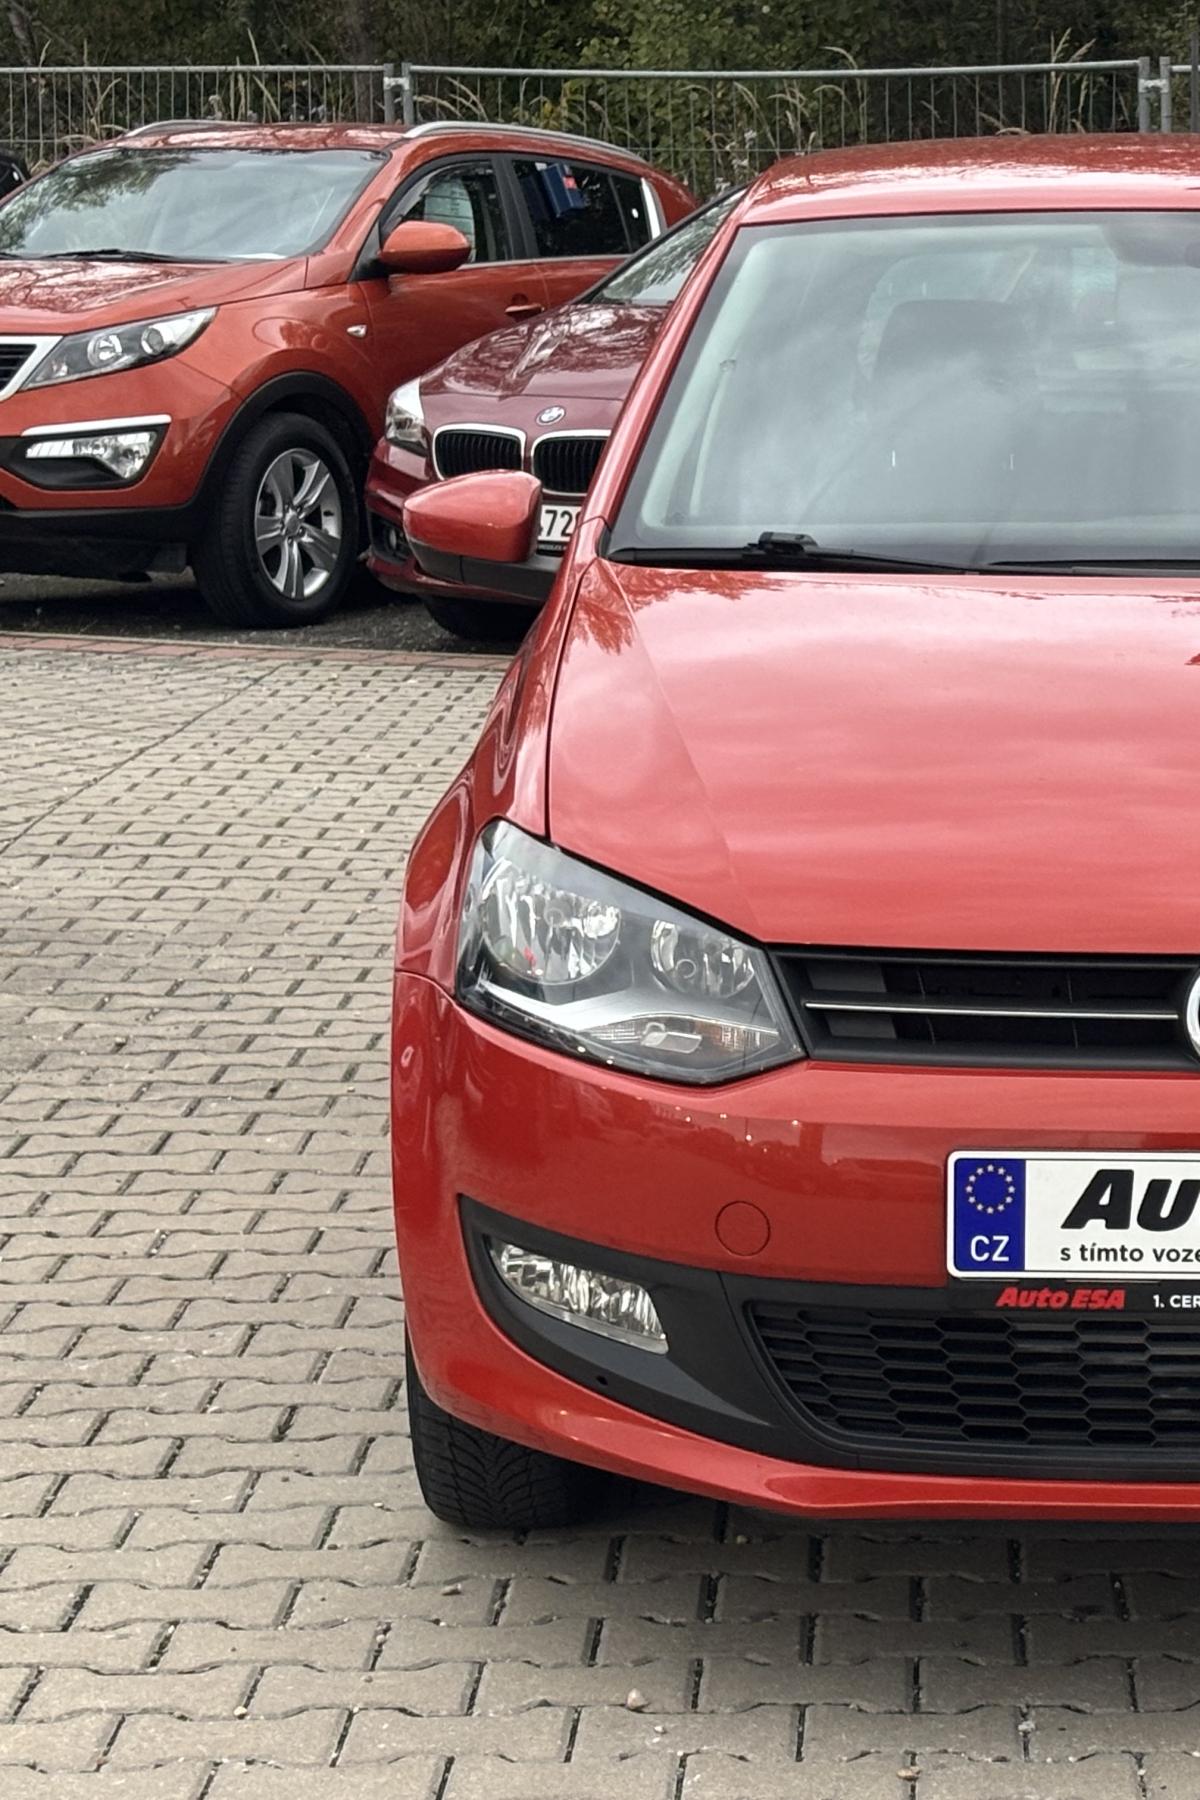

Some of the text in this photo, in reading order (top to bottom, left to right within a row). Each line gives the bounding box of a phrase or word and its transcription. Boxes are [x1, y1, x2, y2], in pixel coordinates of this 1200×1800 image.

[970, 1235, 1010, 1262] CZ
[1060, 1248, 1071, 1262] s
[1079, 1242, 1144, 1263] tímto
[996, 1287, 1126, 1309] Auto ESA
[1153, 1294, 1165, 1308] 1.
